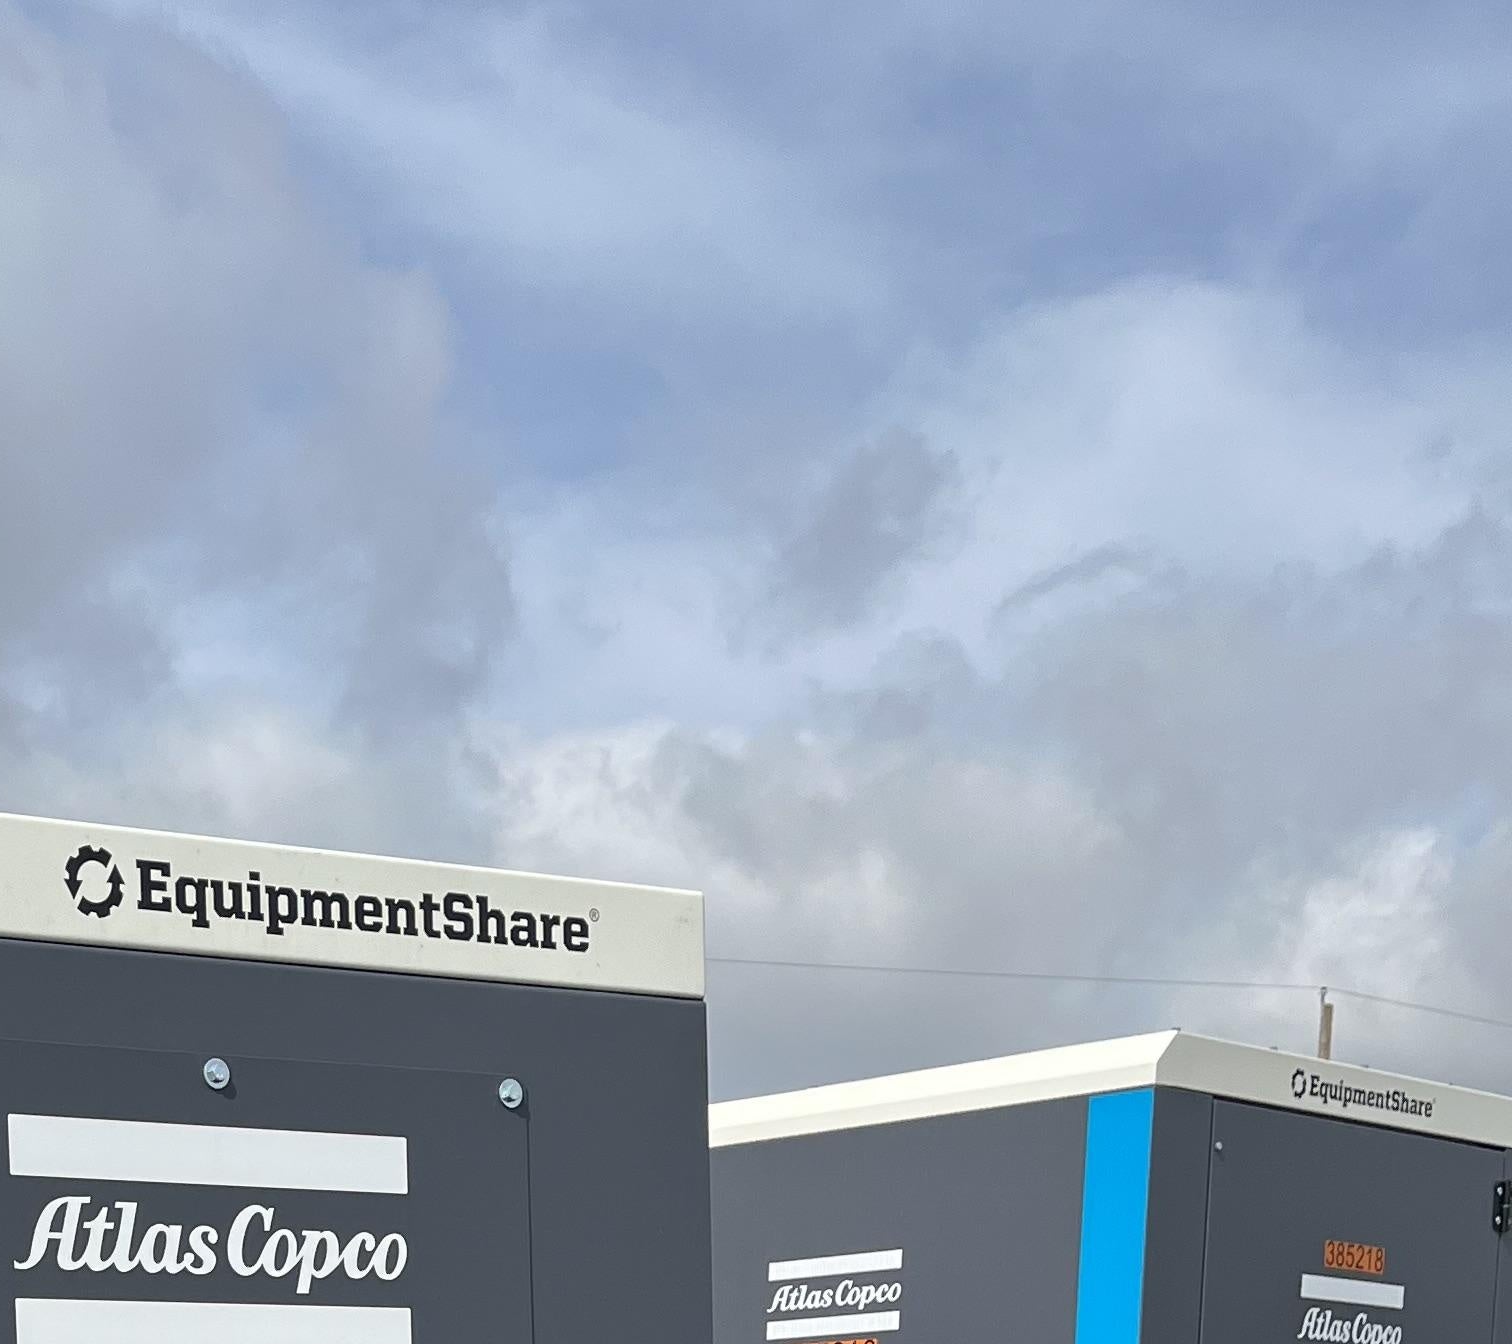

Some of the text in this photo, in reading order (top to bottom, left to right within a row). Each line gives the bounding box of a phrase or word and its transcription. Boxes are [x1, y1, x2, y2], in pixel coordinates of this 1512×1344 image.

[1309, 1074, 1433, 1118] EquipmentShare
[14, 1195, 408, 1294] Atlas Copco
[1326, 1241, 1384, 1273] 385218
[766, 1279, 902, 1314] Atlas Copco
[1297, 1306, 1351, 1344] Atlas
